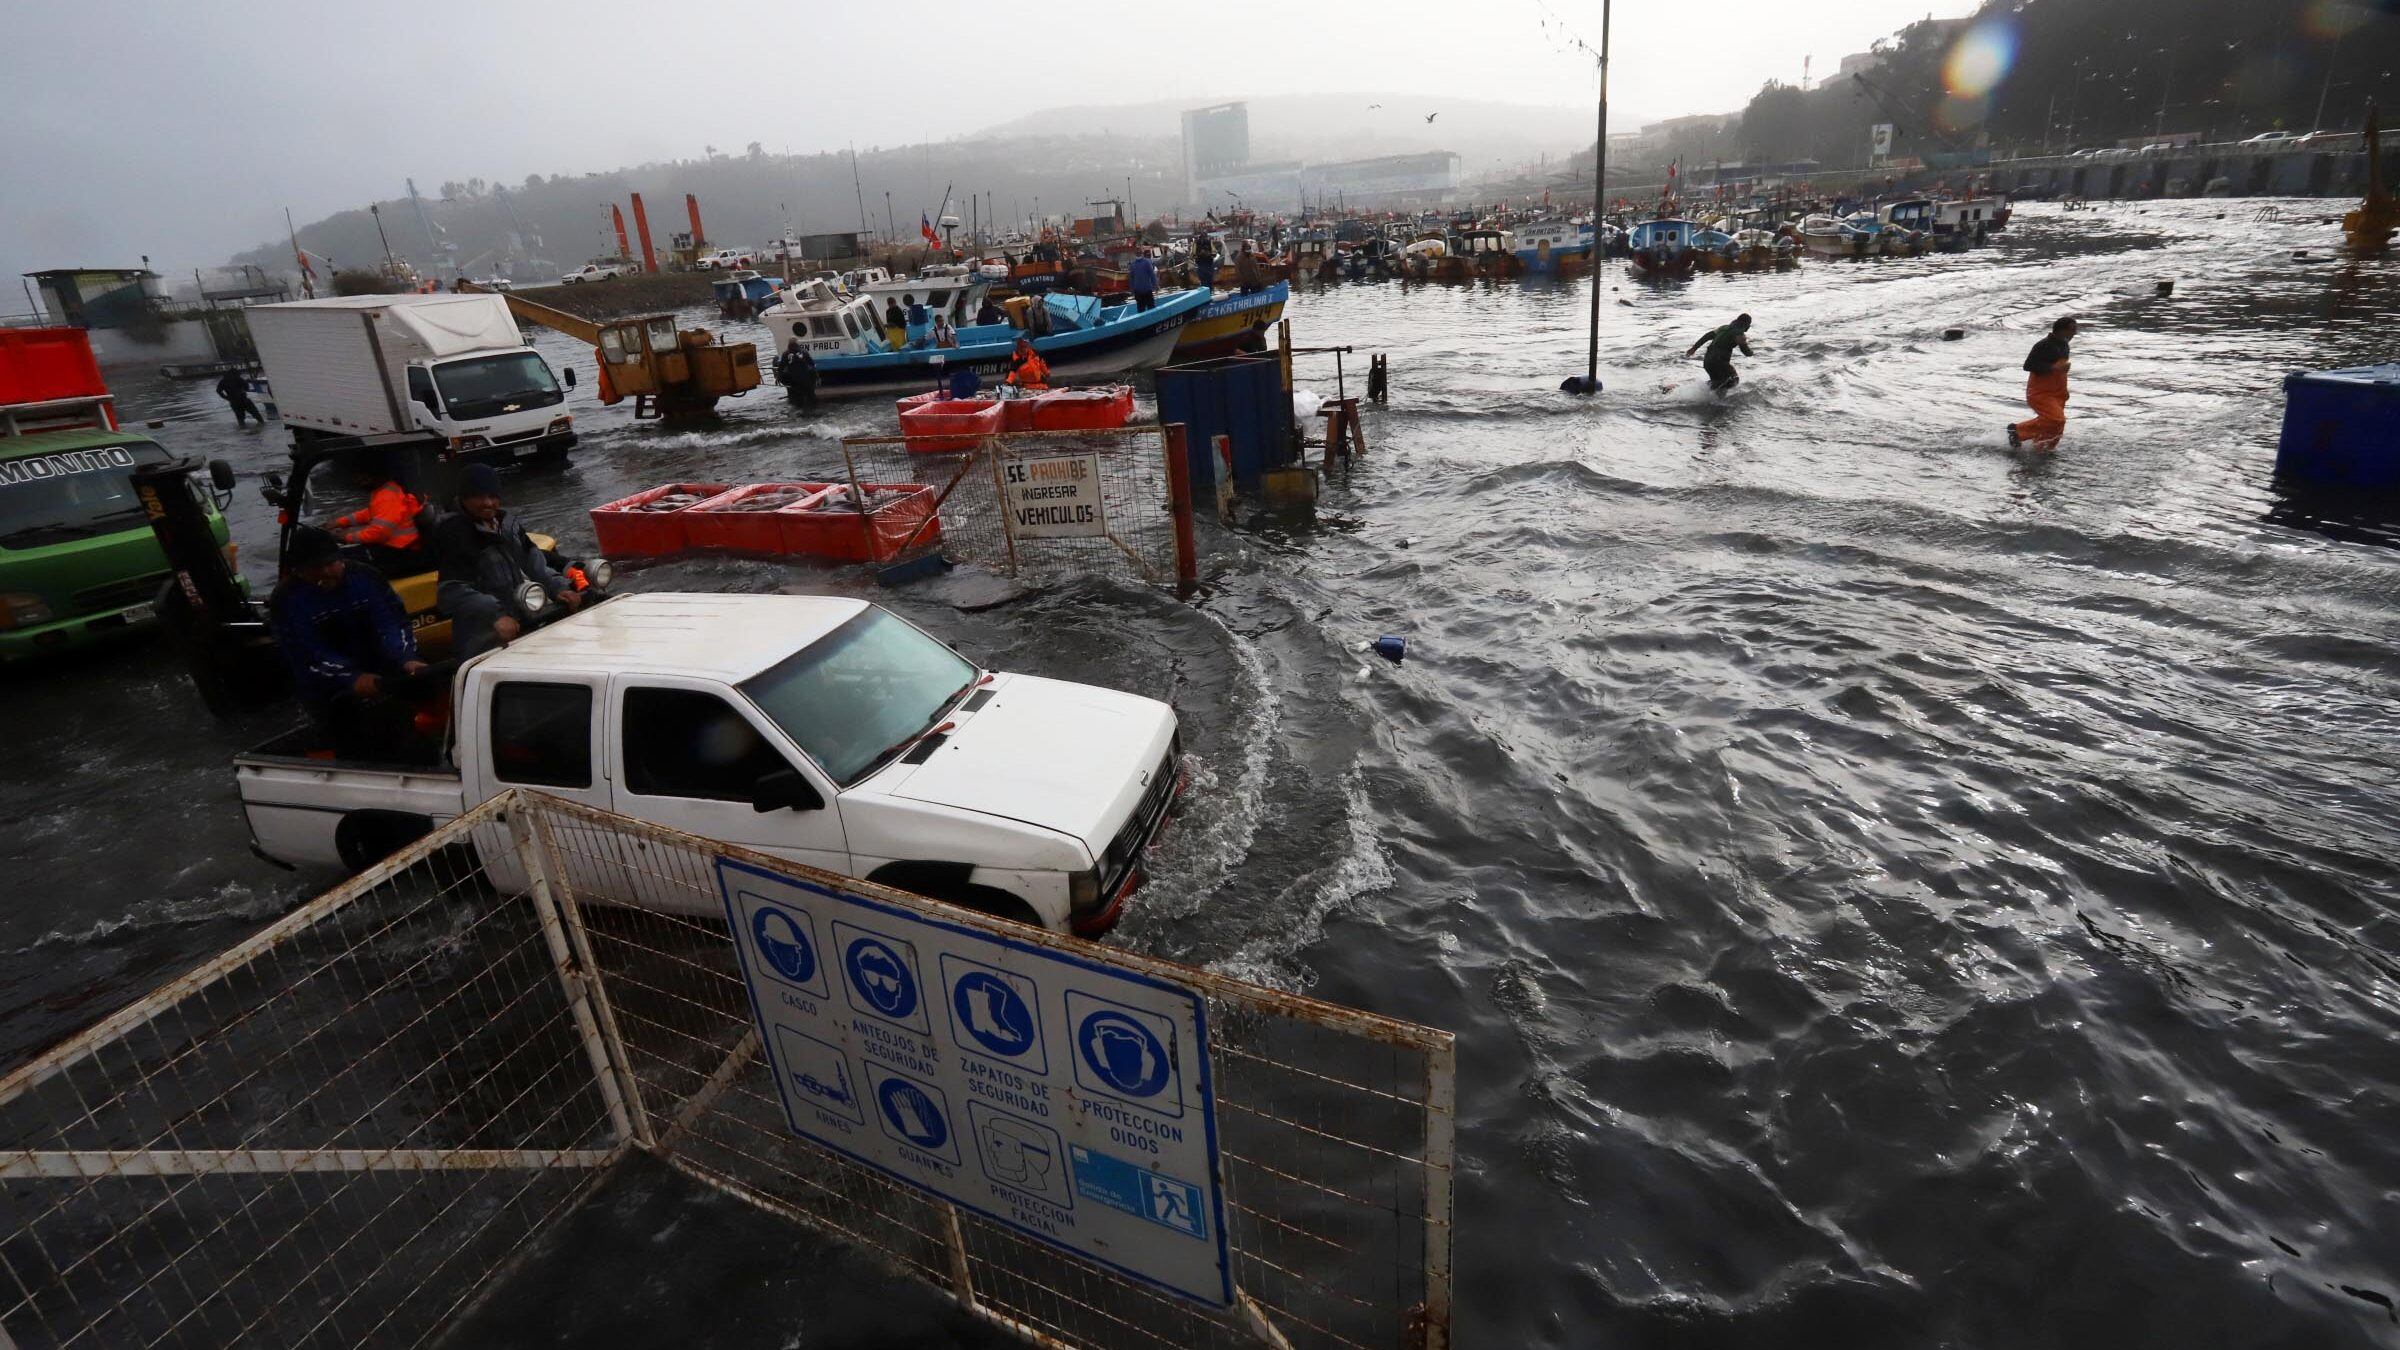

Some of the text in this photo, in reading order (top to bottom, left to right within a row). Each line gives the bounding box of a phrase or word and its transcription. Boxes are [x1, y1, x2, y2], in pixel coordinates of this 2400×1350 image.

[813, 341, 840, 351] PABLO
[0, 447, 134, 485] MONITO
[1007, 460, 1087, 483] SE PROHIBE
[1021, 485, 1077, 501] INGRESAR
[1015, 505, 1094, 526] VEHICULOS
[412, 614, 436, 629] ale
[781, 991, 817, 1016] CASCO
[852, 1019, 941, 1063] ANTEOJOS DE
[864, 1039, 935, 1077] SEGURIDAD
[960, 1057, 1049, 1100] ZAPATOS DE
[968, 1079, 1049, 1117] SEGURIDAD
[816, 1110, 851, 1134] ARNES
[1081, 1100, 1183, 1143] PROTECCION
[1110, 1126, 1159, 1154] OIDOS
[991, 1184, 1076, 1228] PROTECCION
[1011, 1209, 1057, 1234] FACIAL
